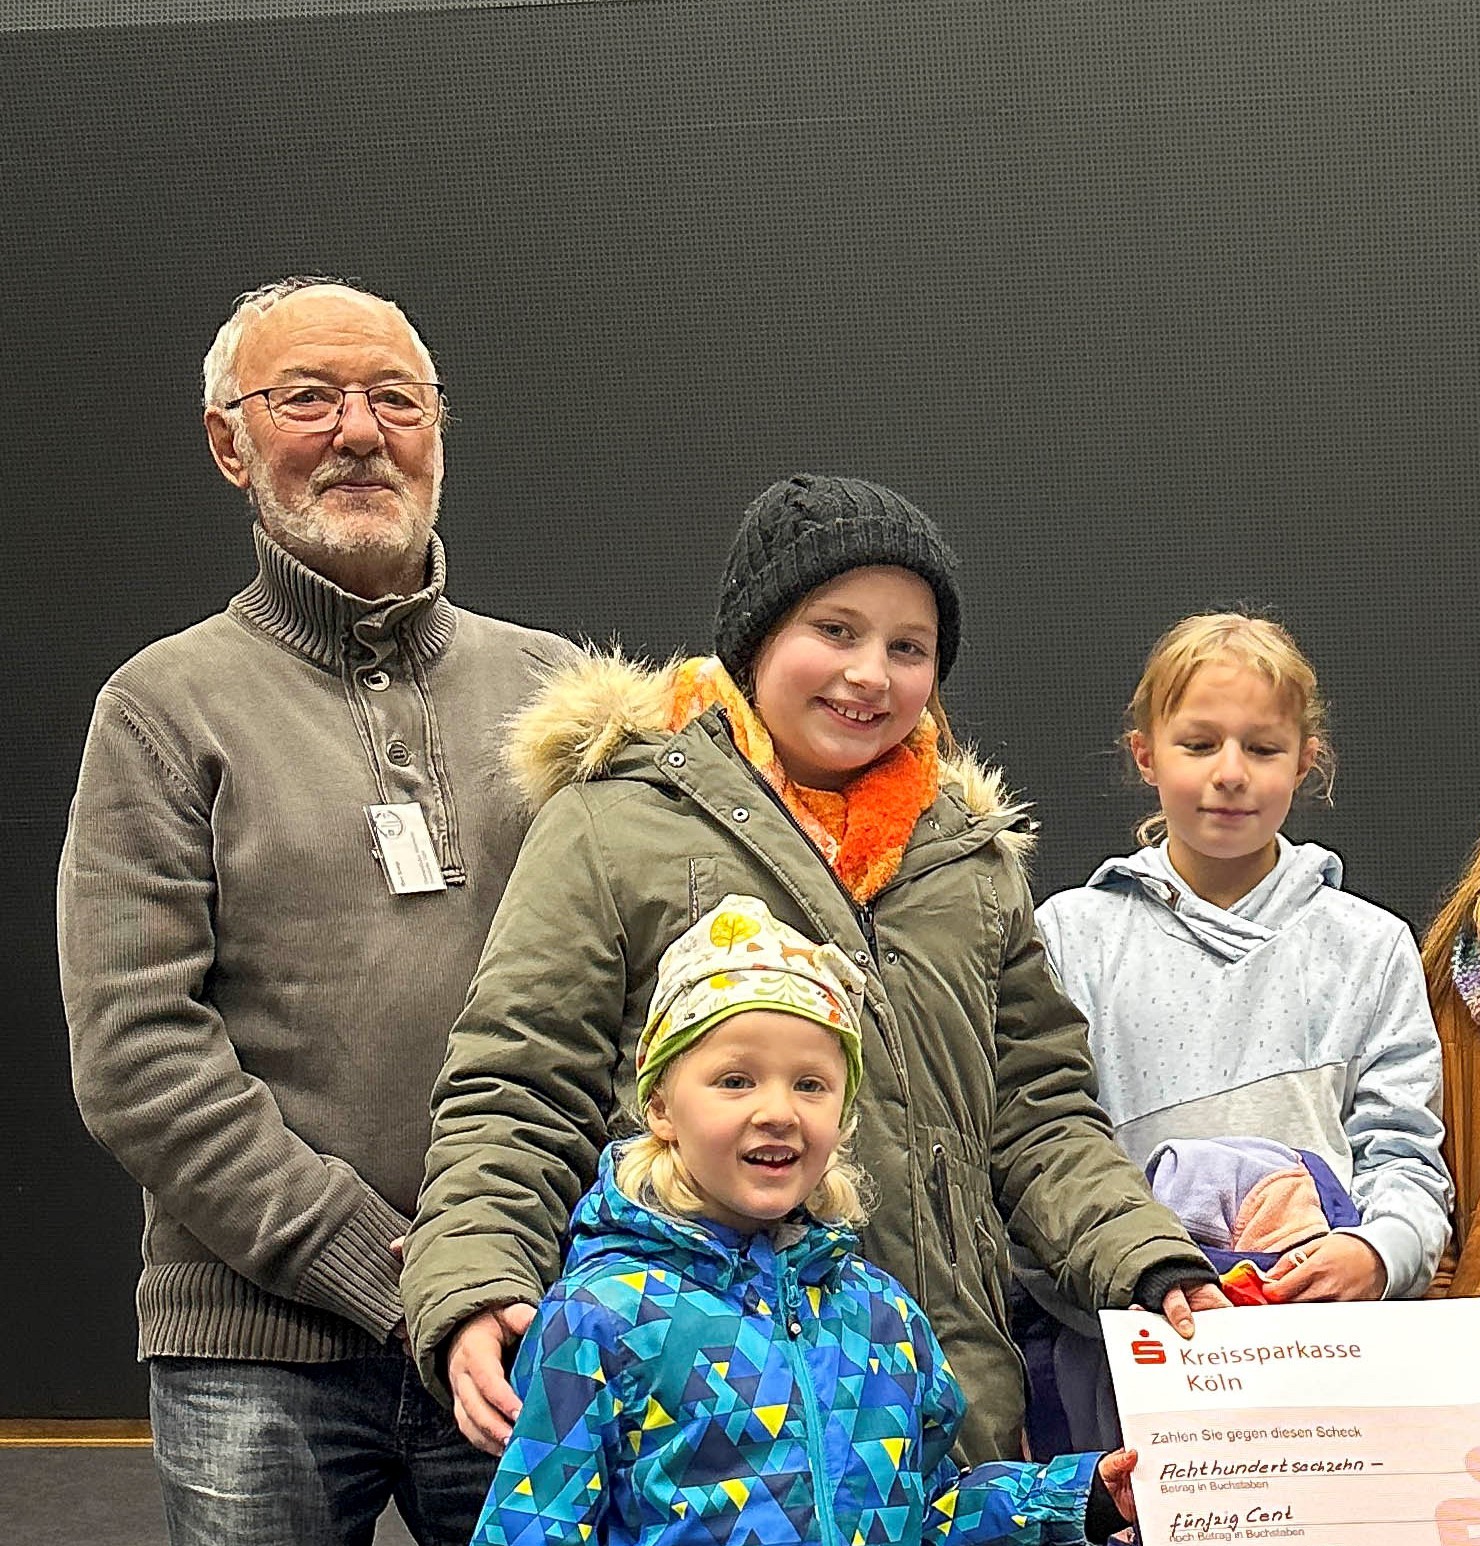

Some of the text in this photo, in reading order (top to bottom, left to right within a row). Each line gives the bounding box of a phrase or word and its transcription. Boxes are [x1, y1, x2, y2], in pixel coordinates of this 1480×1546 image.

[1179, 1340, 1362, 1365] Kreissparkasse
[1186, 1373, 1243, 1392] Köln
[1151, 1426, 1363, 1445] Zahlen Sie gegen diesen Scheck
[1160, 1480, 1270, 1494] Betrag in Buchstaben
[1170, 1505, 1294, 1537] fünfzig Cent
[1169, 1528, 1305, 1543] noch Betrag in Buchstaben
